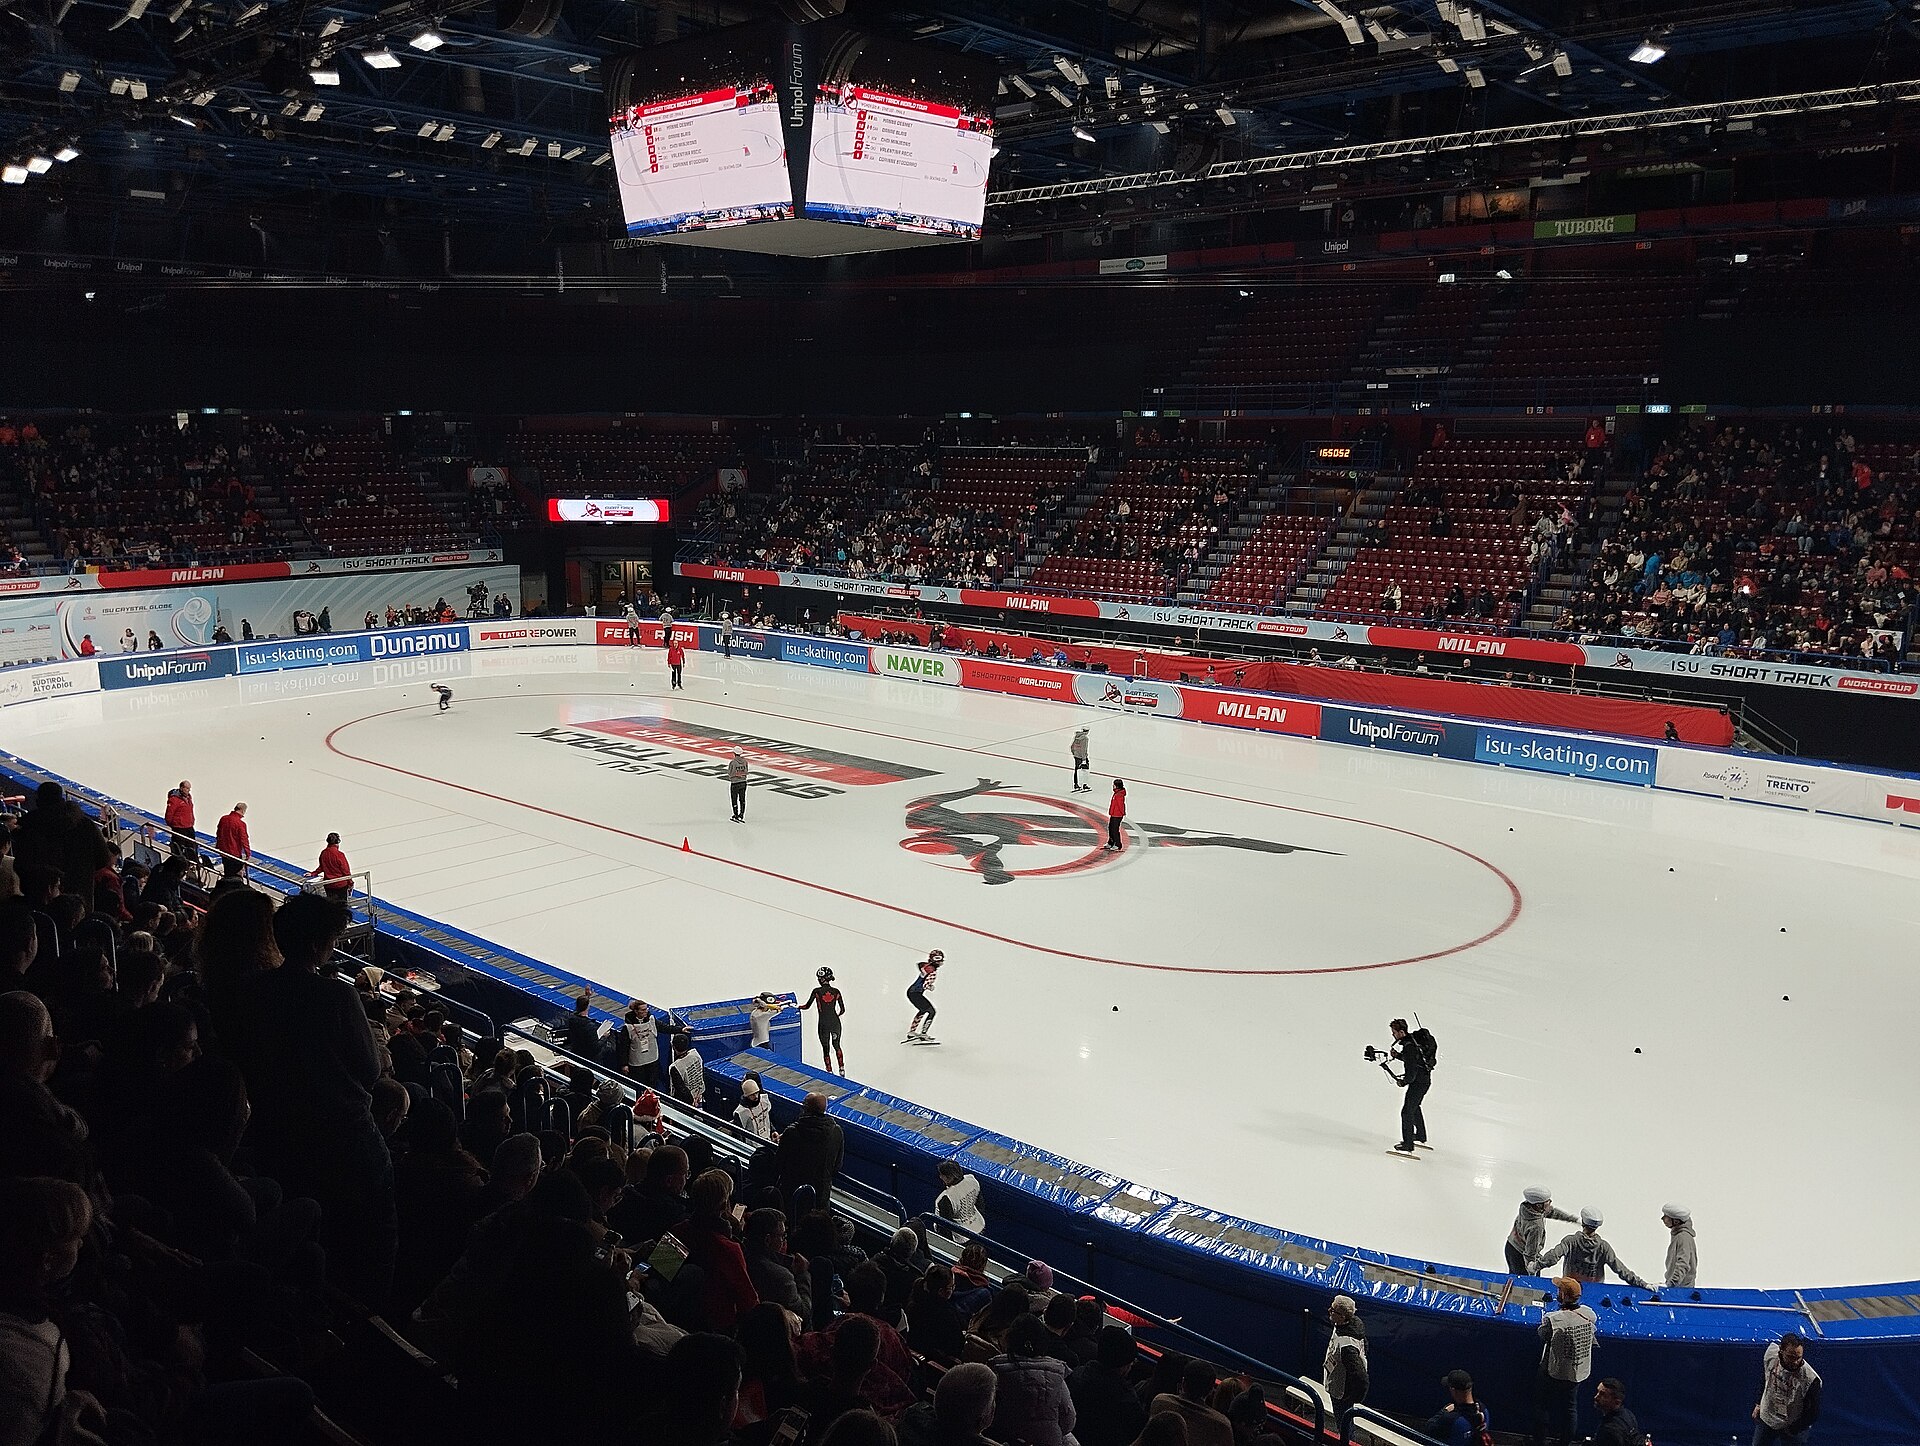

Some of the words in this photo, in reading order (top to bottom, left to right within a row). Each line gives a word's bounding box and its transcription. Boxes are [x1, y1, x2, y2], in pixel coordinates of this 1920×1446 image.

[789, 42, 808, 127] UnipolForum
[1554, 217, 1615, 236] TUBORG
[1323, 239, 1349, 254] Unipol
[43, 258, 92, 270] UnipolForum
[116, 261, 143, 273] Unipol
[342, 558, 359, 570] ISU
[365, 557, 398, 568] SHORT
[399, 555, 430, 566] TRACK
[171, 567, 225, 582] MILAN
[713, 569, 745, 581] MILAN
[17, 582, 37, 590] TOUR
[816, 578, 830, 588] ISU
[833, 580, 860, 592] SHORT
[861, 583, 886, 595] TRACK
[115, 605, 148, 613] CRYSTAL
[1006, 596, 1050, 611] MILAN
[803, 608, 810, 620] 4
[1153, 611, 1171, 622] ISU
[1177, 614, 1215, 627] SHORT
[1217, 618, 1255, 631] TRACK
[1260, 623, 1285, 632] WORLD
[1286, 625, 1305, 633] TOUR
[498, 631, 526, 639] TEATRO
[529, 627, 577, 639] REPOWER
[714, 632, 764, 651] UnolForum
[370, 631, 460, 657] Dunamu
[786, 642, 866, 665] isu-skating.com
[1438, 636, 1507, 656] MILAN
[245, 642, 358, 667] isu-skating.com
[126, 661, 207, 681] UnipolForum
[886, 653, 945, 678] NAVER
[51, 681, 73, 690] ADIGE
[1670, 660, 1699, 673] ISU
[1710, 664, 1772, 681] SHORT
[1774, 670, 1834, 688] TRACK
[1843, 679, 1883, 690] WORLD
[1883, 683, 1912, 692] TOUR
[1216, 701, 1287, 723] MILAN
[1349, 716, 1439, 746] UnipolForum
[718, 735, 813, 754] MILAN
[1485, 734, 1650, 775] isu-skating.com
[1766, 779, 1810, 793] TRENTO
